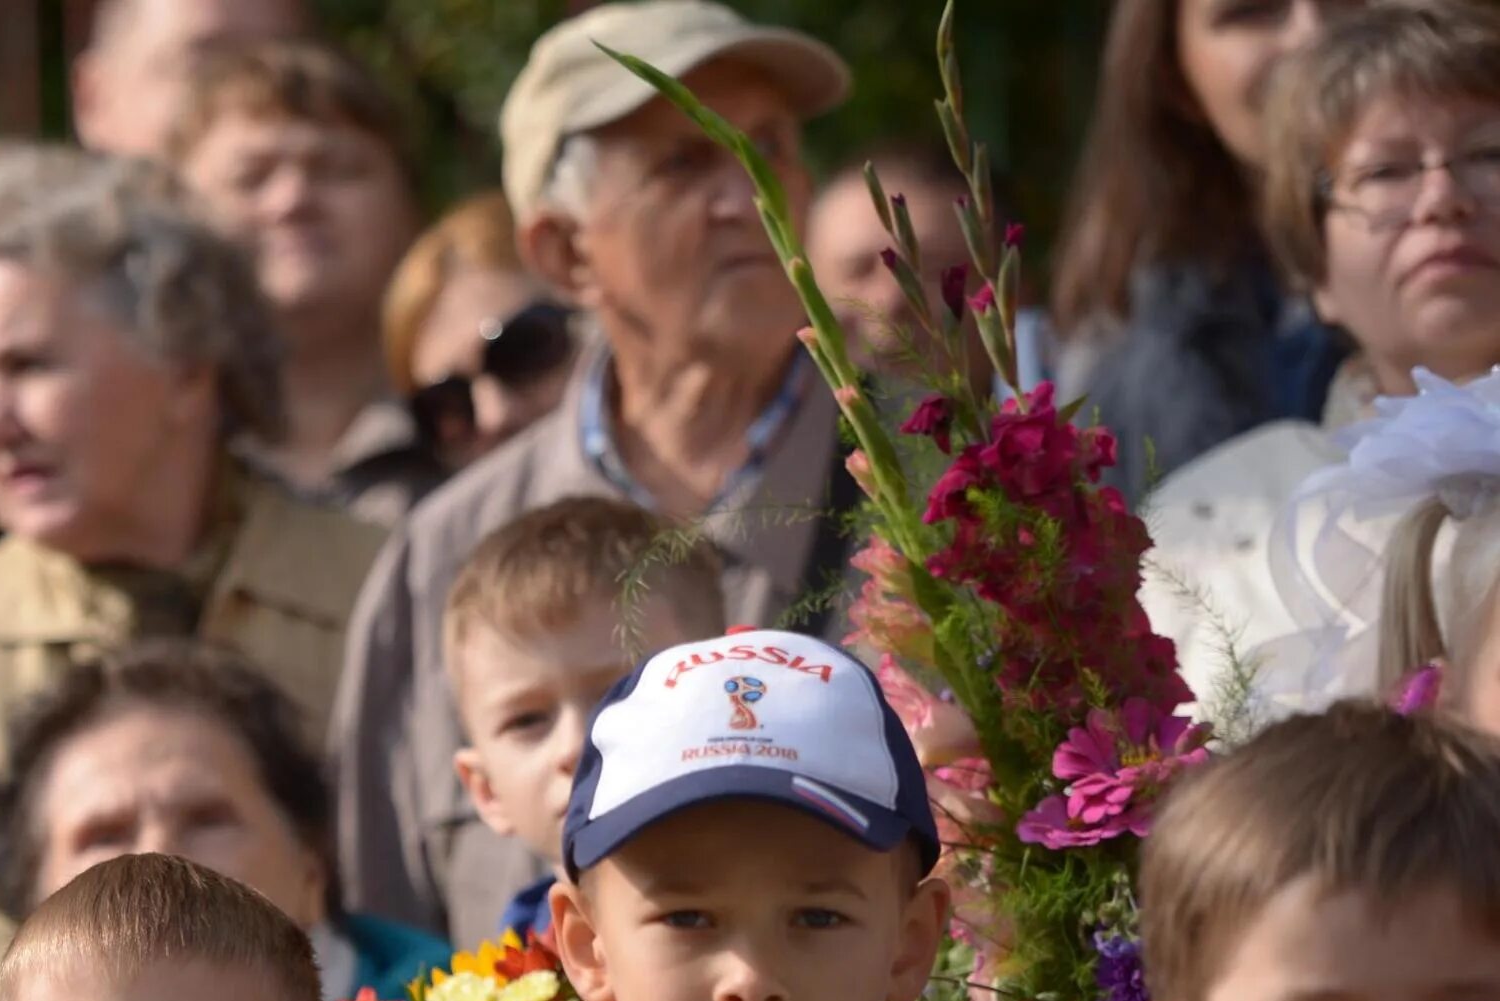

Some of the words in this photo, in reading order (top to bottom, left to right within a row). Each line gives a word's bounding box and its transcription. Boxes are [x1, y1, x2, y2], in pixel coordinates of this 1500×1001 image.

[664, 645, 833, 689] RUSSIA
[681, 743, 751, 761] RUSSIA
[755, 744, 798, 761] 2018
